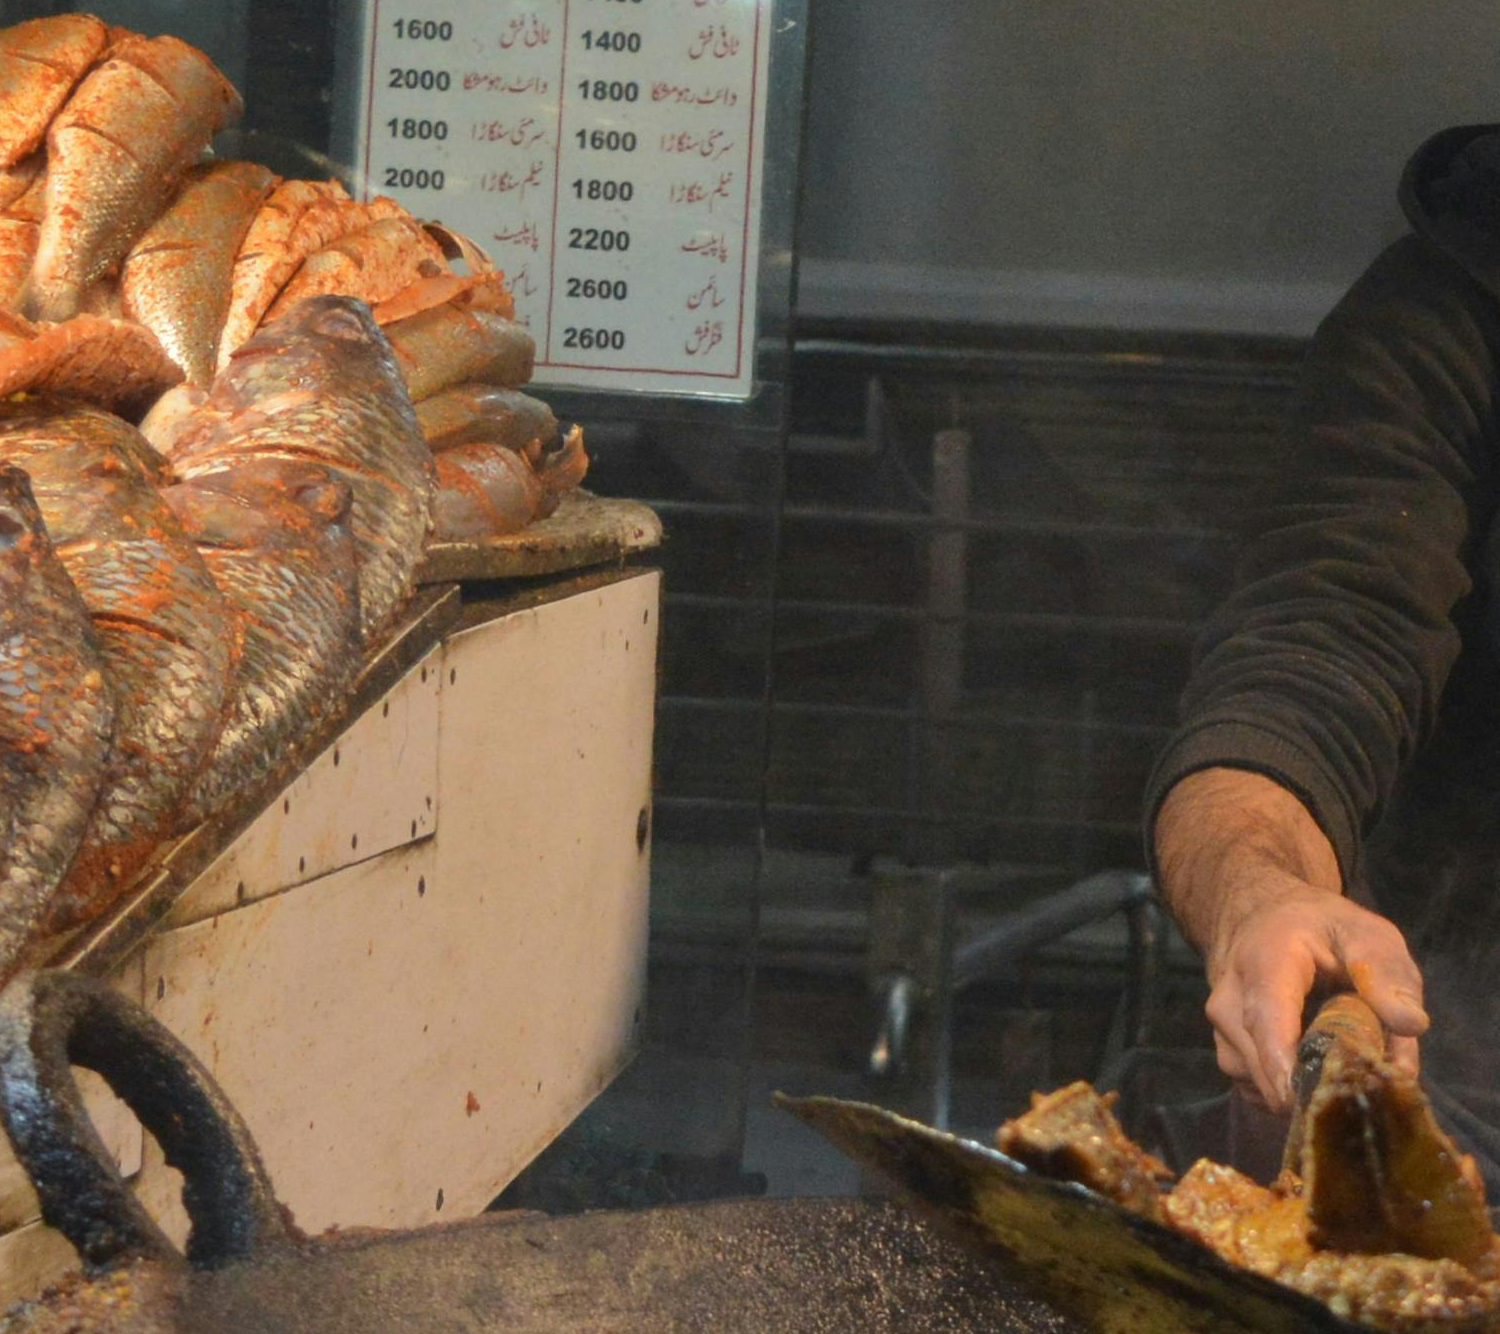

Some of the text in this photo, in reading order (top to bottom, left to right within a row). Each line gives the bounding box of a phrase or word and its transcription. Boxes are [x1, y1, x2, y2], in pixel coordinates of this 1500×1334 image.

[393, 18, 453, 41] 1600
[581, 30, 641, 53] 1400
[388, 68, 451, 92] 2000
[578, 79, 639, 103] 1800
[387, 117, 448, 141] 1800
[575, 128, 637, 152] 1600
[384, 167, 445, 191] 2000
[572, 178, 633, 202] 1800
[568, 228, 630, 252] 2200
[567, 277, 628, 301] 2600
[563, 327, 625, 350] 2600
